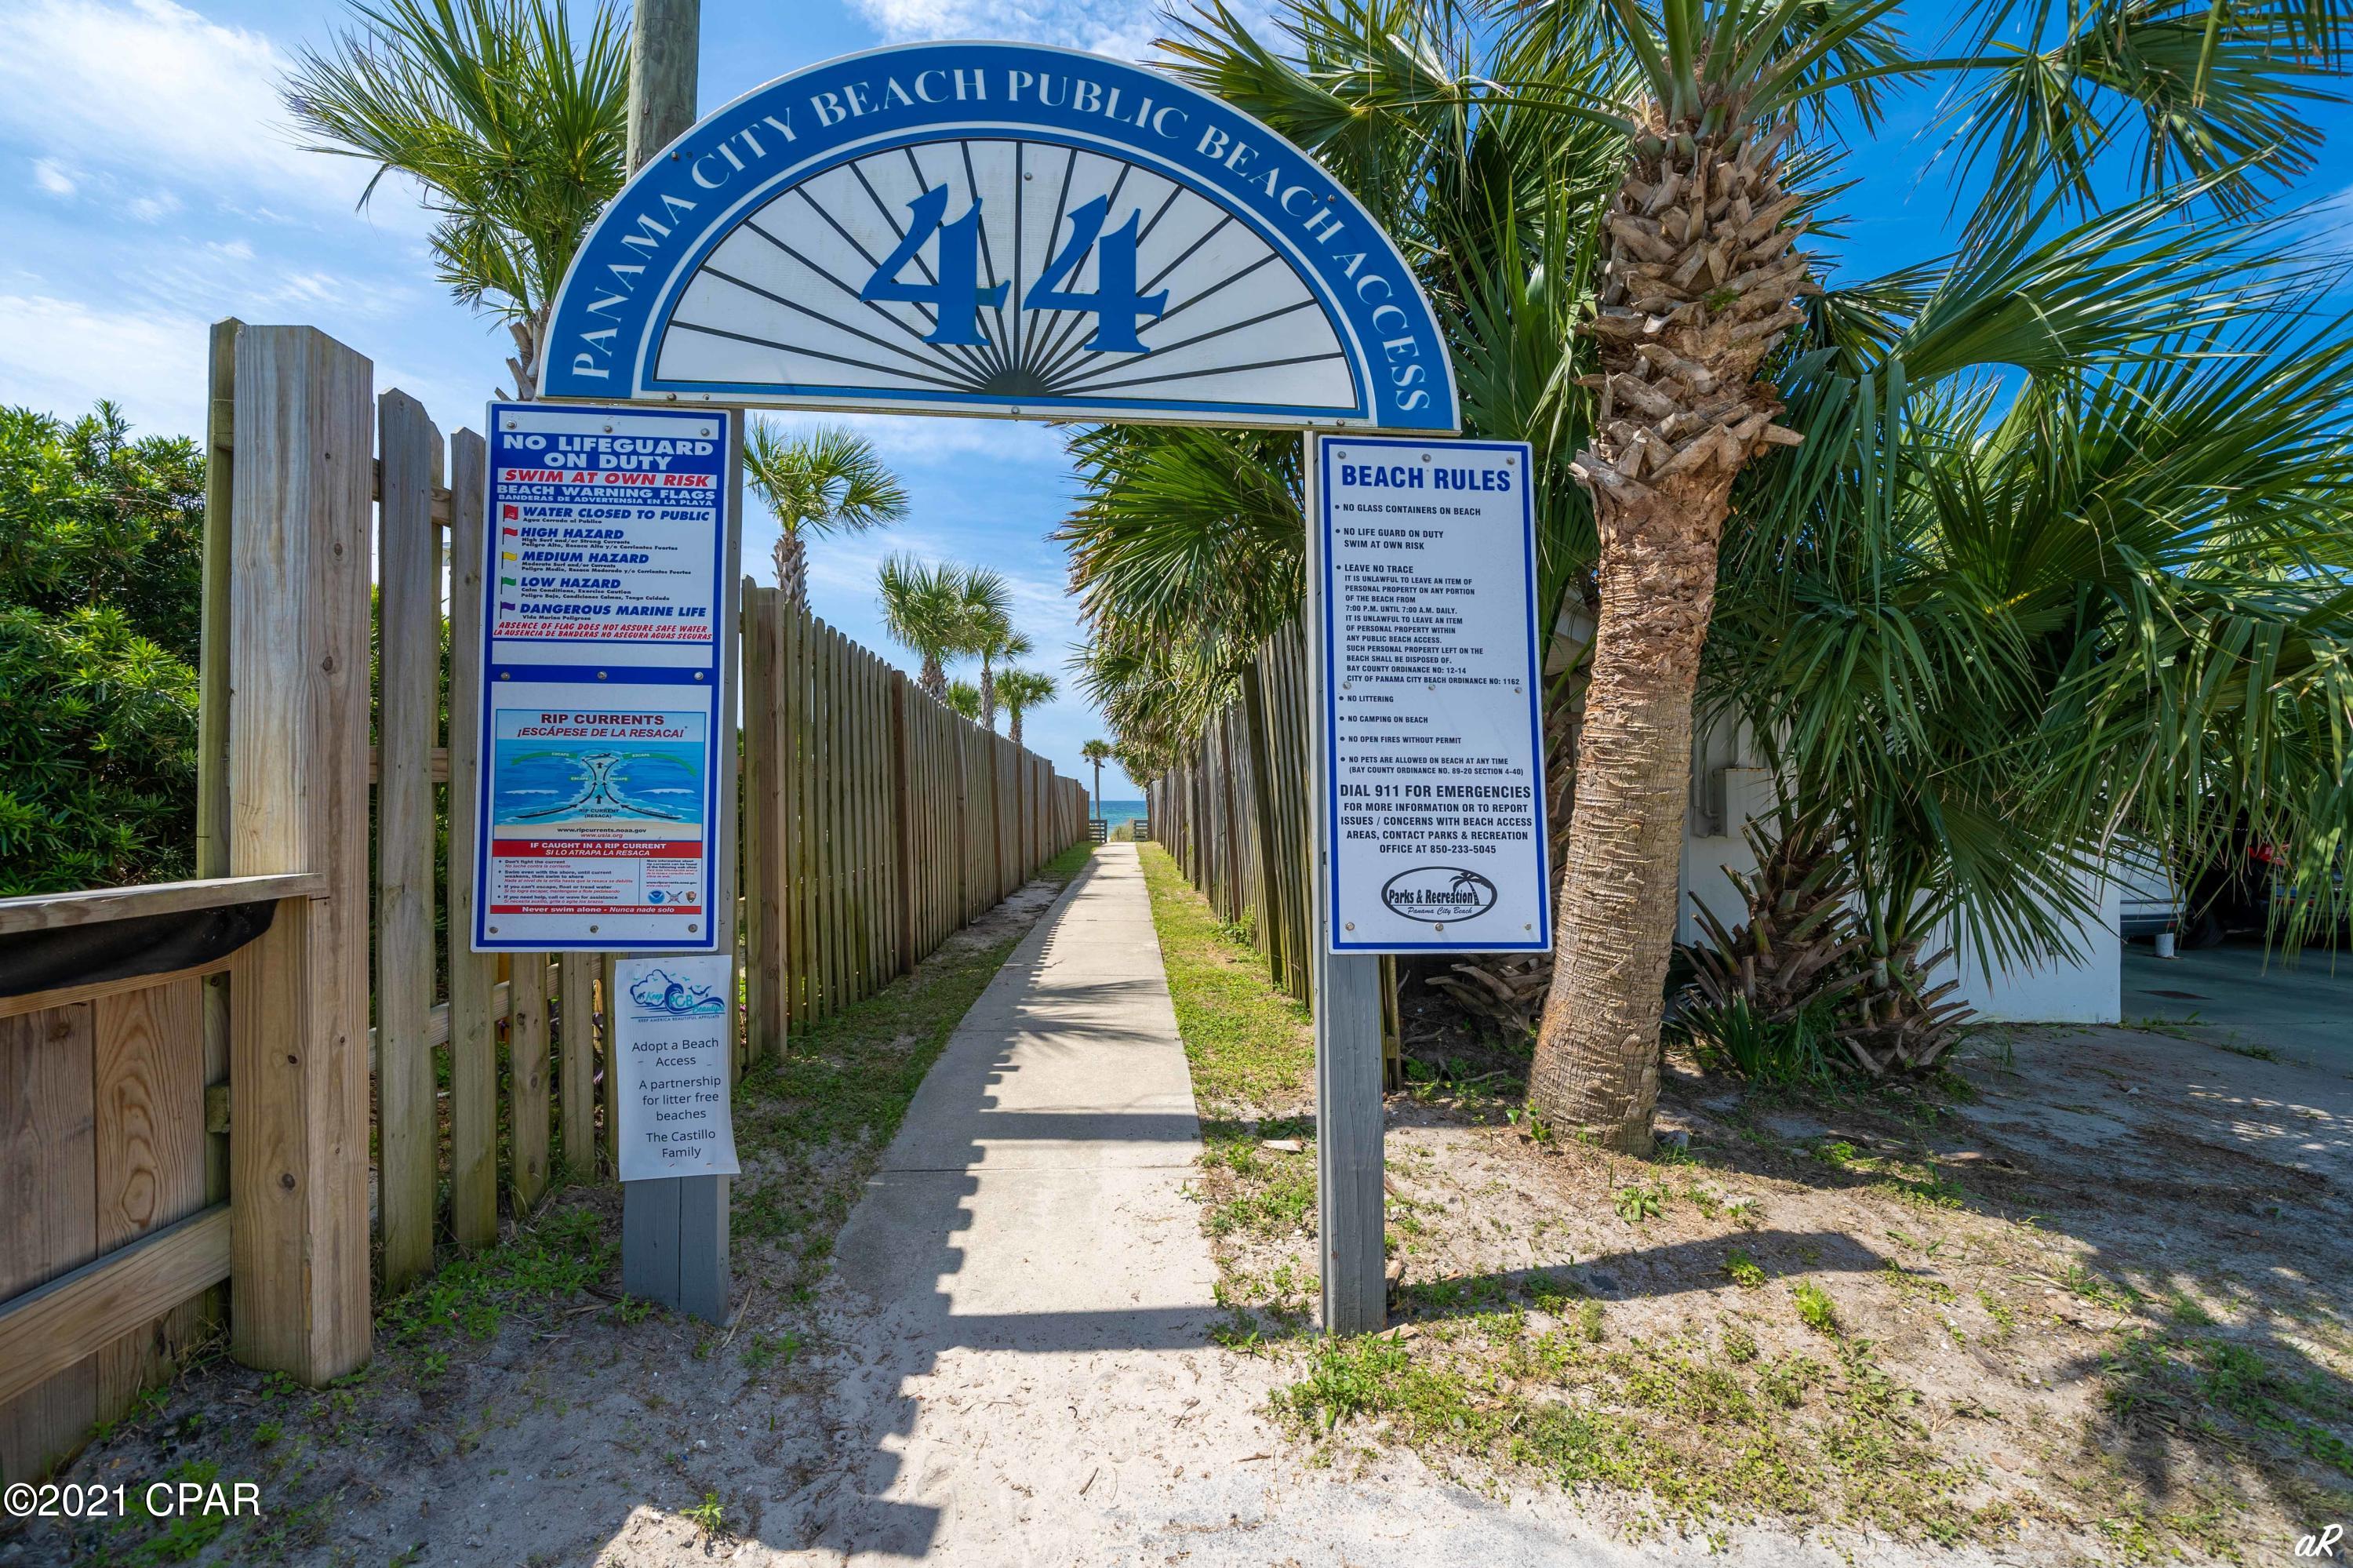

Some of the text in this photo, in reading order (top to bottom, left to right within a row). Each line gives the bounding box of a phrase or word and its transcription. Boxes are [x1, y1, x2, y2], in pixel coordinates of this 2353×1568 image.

[572, 68, 1431, 412] PANAMA CITY BEACH PUBLIC BEACH ACCESS
[503, 434, 713, 455] NO LIFEGUARD
[544, 452, 672, 470] ON DUTY
[504, 469, 710, 486] SWIM AT OWN RISK
[1341, 464, 1510, 491] BEACH RULES
[496, 484, 715, 500] BEACH WARNING FLAGS
[522, 506, 709, 521] WATER CLOSED TO PUBLIC
[1357, 504, 1383, 512] GLASS
[1385, 504, 1437, 514] CONTAINERS
[1439, 506, 1450, 515] ON
[1453, 507, 1480, 515] BEACH
[520, 526, 624, 539] HIGH HAZARD
[1377, 528, 1406, 537] GUARD
[1422, 529, 1443, 538] DUTY
[521, 551, 649, 563] MEDIUM HAZARD
[1344, 563, 1413, 573] LEAVE NO TRACE
[520, 577, 620, 588] LOW HAZARD
[519, 602, 706, 617] DANGEROUS MARINE LIFE
[498, 620, 538, 629] ABSENCE
[540, 713, 664, 725] RIP CURRENTS
[518, 726, 684, 737] ¡ESCÁPESE DE LA RESACA!
[1340, 784, 1530, 798] DIAL 911 FOR EMERGENCIES
[1379, 844, 1496, 853] OFFICE AT 850-233-5045
[1389, 889, 1473, 904] Parks & Recreation
[1437, 906, 1451, 915] City
[631, 1041, 667, 1053] Adopt
[682, 1037, 718, 1050] Beach
[655, 1057, 696, 1067] Access
[638, 1075, 721, 1092] A partnership
[642, 1092, 718, 1105] for litter free
[656, 1109, 706, 1121] beaches
[646, 1129, 715, 1142] The Castillo
[661, 1145, 701, 1159] Family
